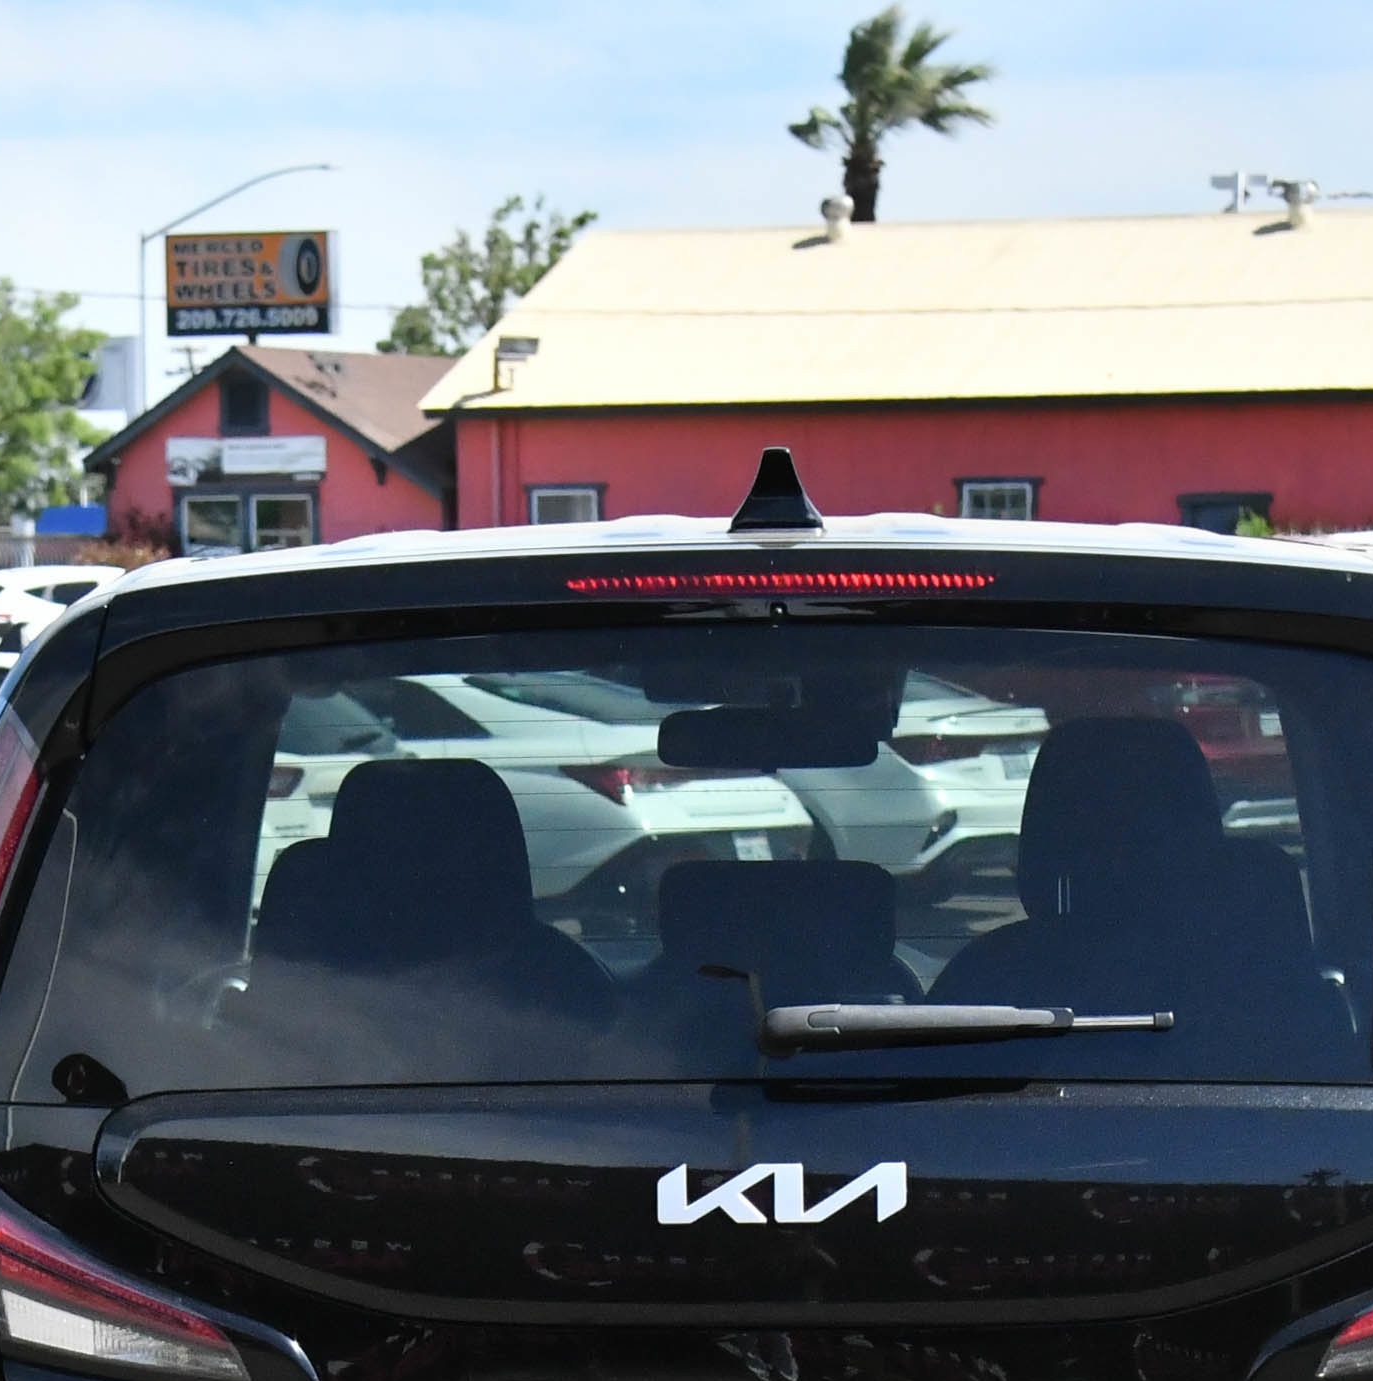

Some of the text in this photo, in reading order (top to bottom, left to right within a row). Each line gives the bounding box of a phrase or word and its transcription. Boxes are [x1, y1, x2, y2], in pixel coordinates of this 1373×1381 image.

[174, 239, 264, 254] MERCED
[175, 258, 256, 278] TIRES
[175, 281, 277, 300] WHEELS
[657, 1162, 907, 1224] KIA
